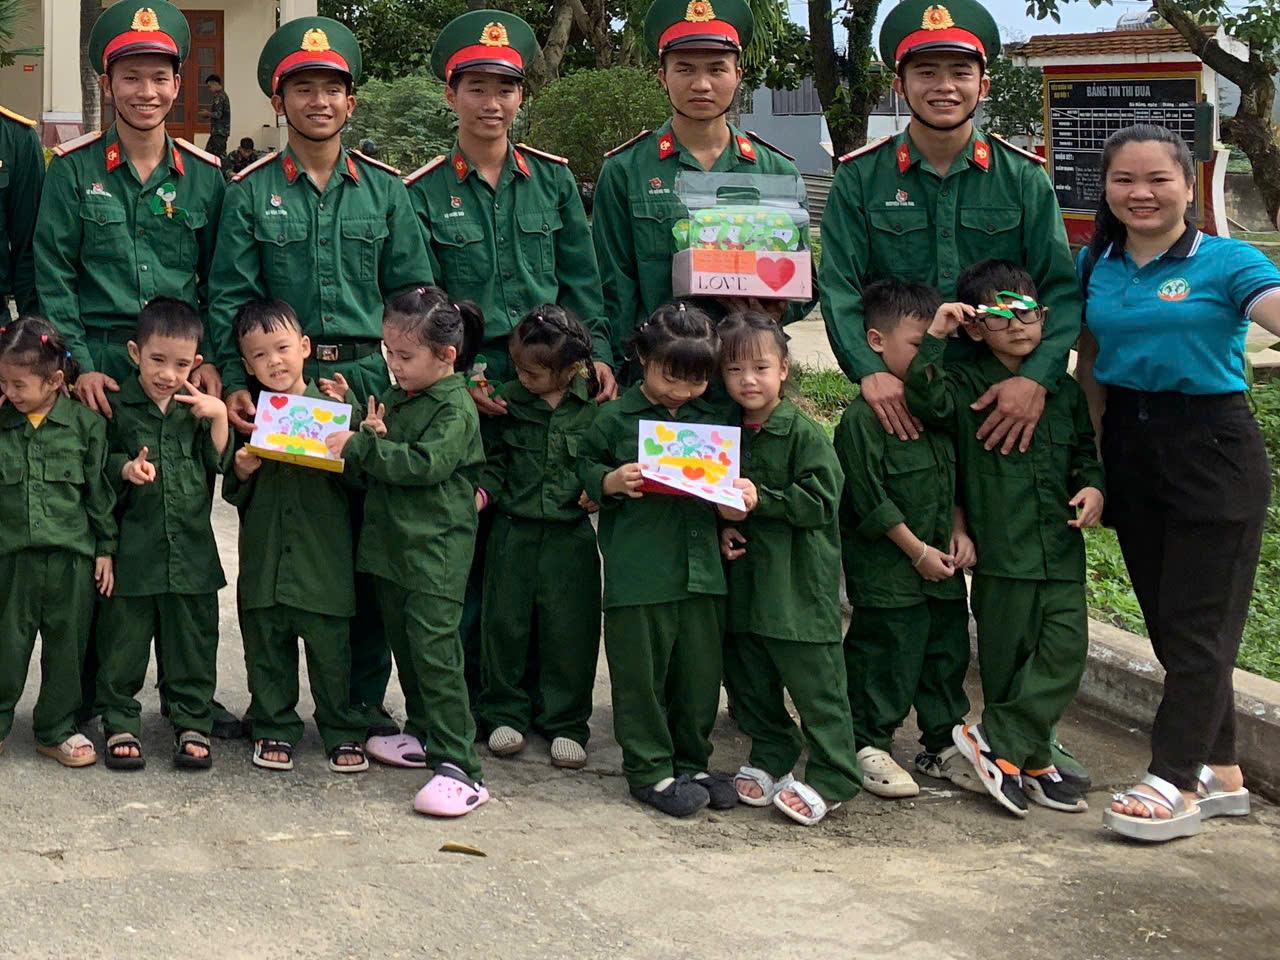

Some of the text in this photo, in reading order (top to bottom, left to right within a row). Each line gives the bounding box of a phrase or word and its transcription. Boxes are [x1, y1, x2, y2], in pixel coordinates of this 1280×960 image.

[1086, 82, 1107, 97] BẢNG
[1108, 85, 1121, 97] TIN
[1121, 85, 1134, 97] THI
[1134, 85, 1151, 97] ĐUA
[698, 275, 748, 291] LOVE
